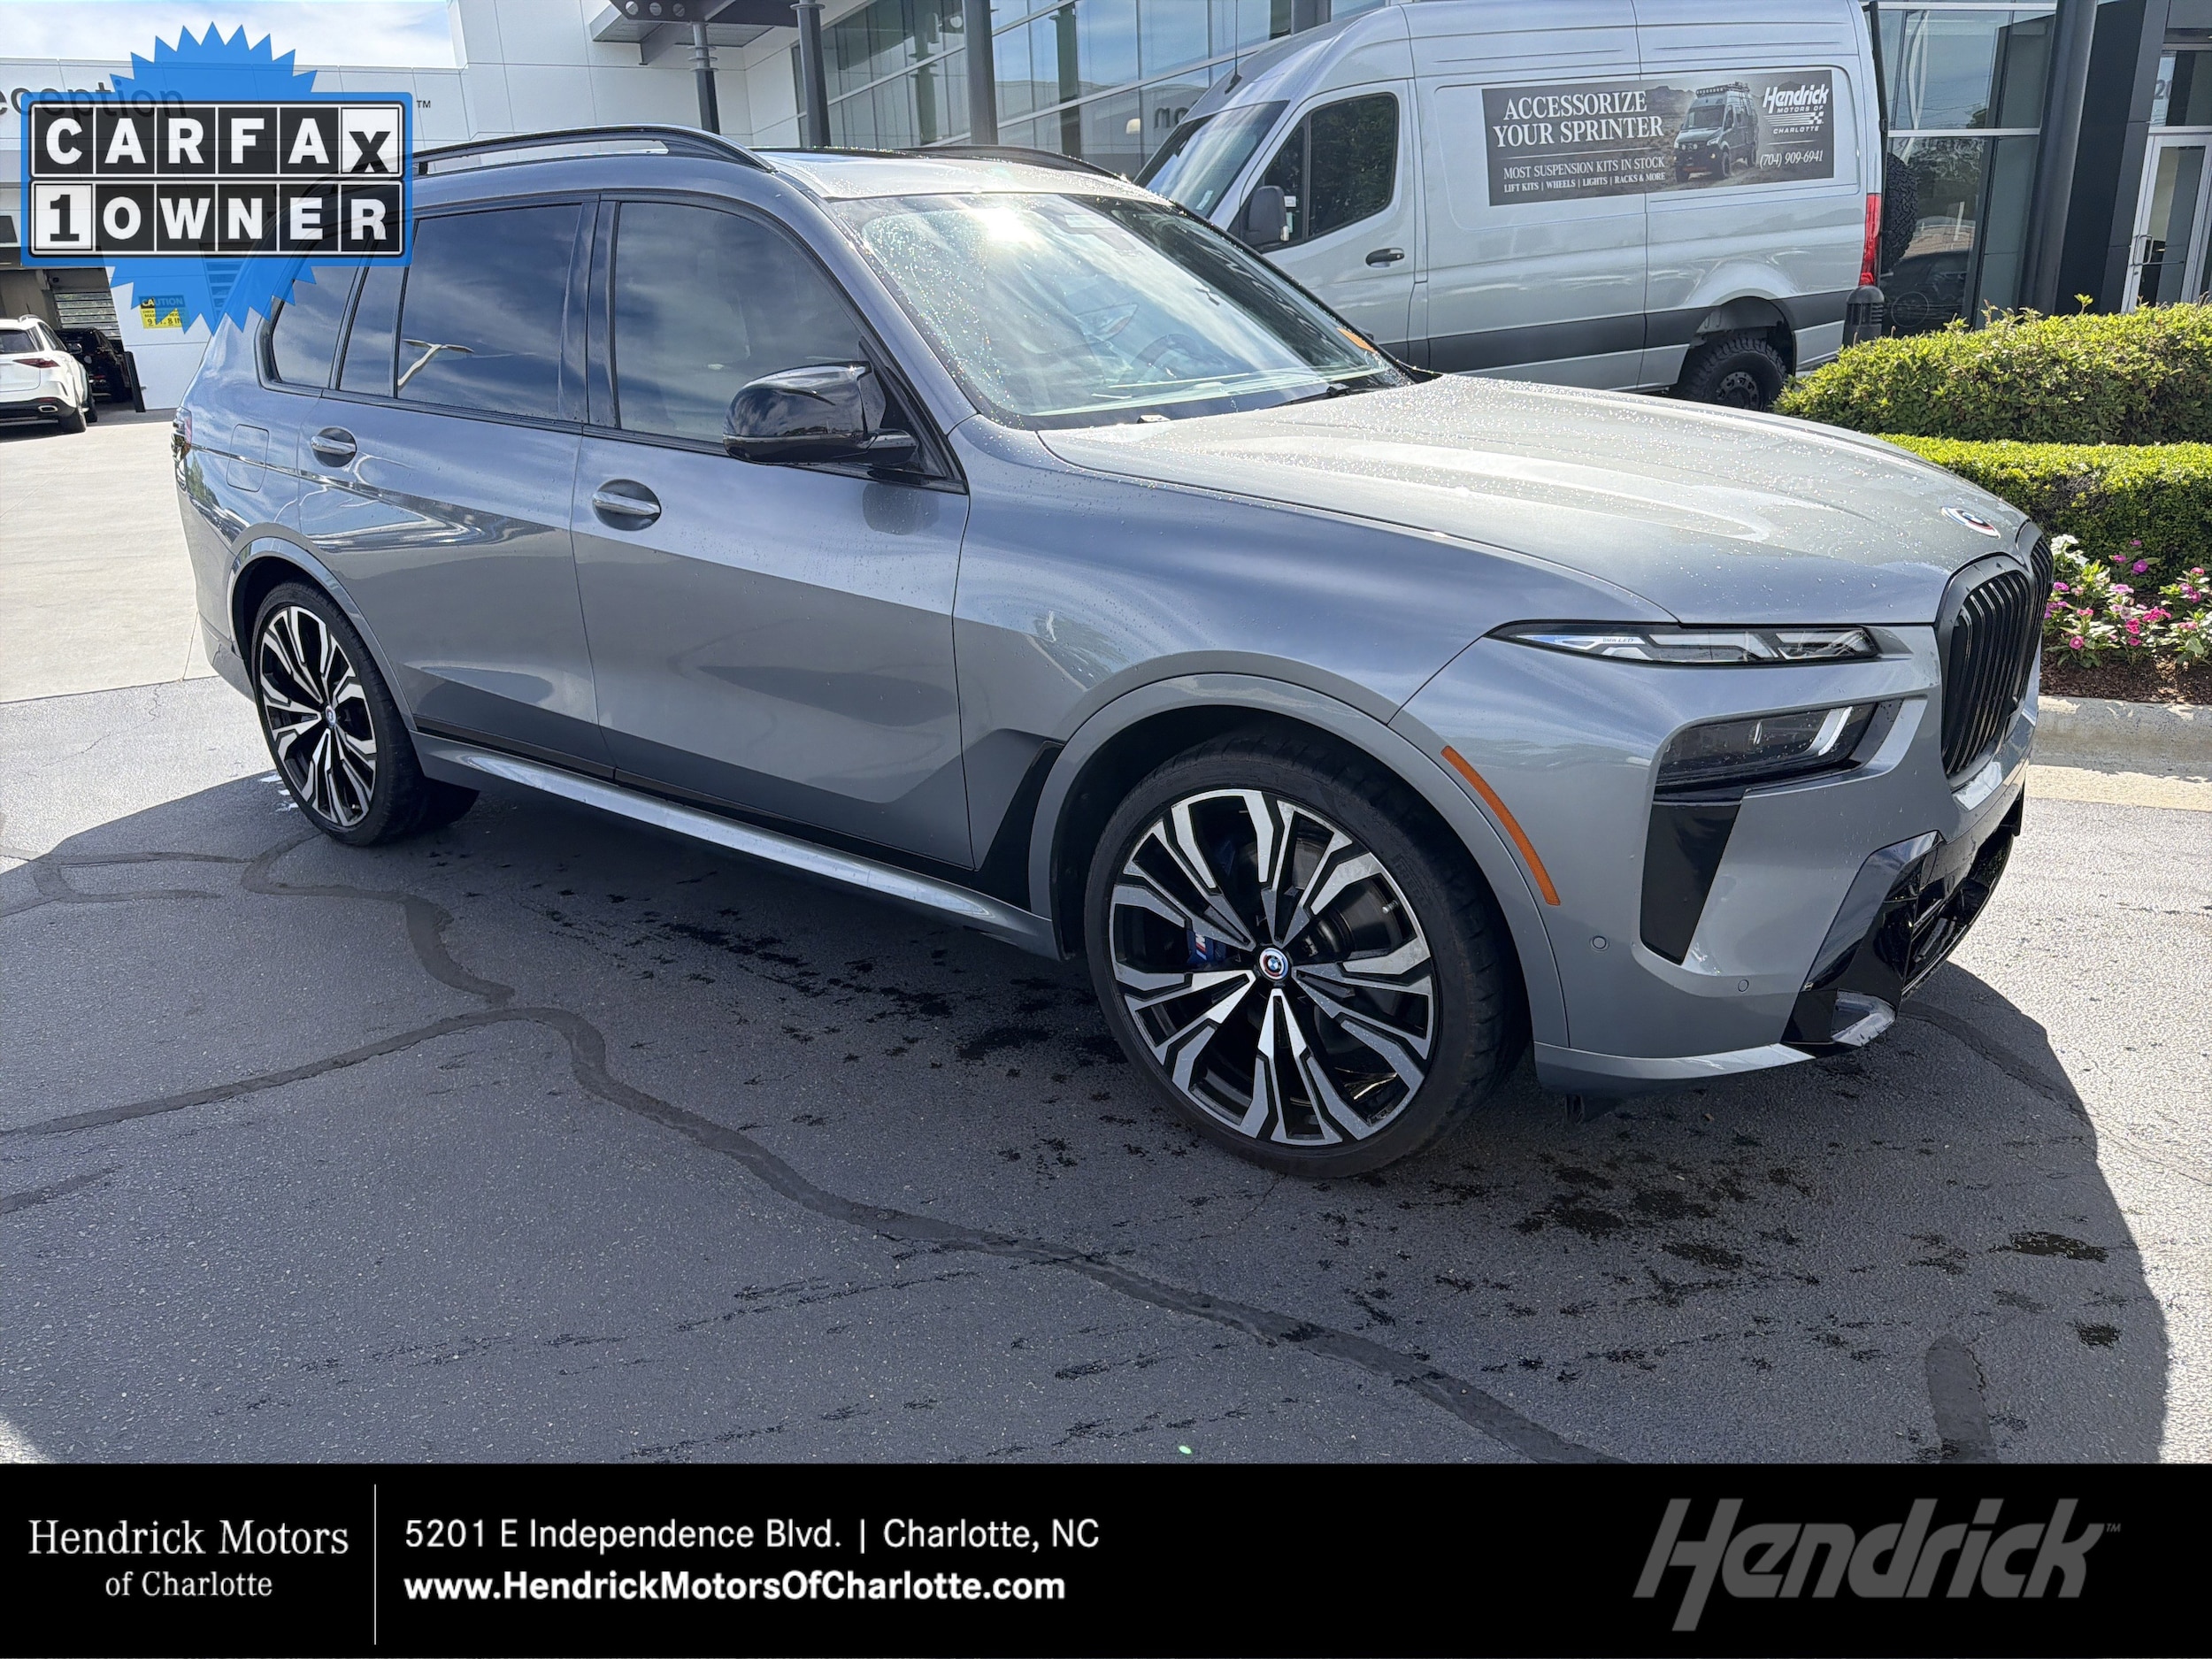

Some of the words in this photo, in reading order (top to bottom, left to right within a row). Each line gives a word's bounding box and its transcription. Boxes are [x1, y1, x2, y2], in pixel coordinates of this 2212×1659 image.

[1503, 91, 1647, 120] ACCESSORIZE
[1763, 84, 1829, 113] Hendrick
[1493, 123, 1555, 148] YOUR
[1560, 116, 1664, 143] SPRINTER
[1773, 126, 1819, 134] CHARLOTTE
[1503, 166, 1531, 180] MOST
[1533, 161, 1594, 178] SUSPENSION
[1596, 160, 1619, 173] KITS
[1621, 159, 1632, 170] IN
[1634, 157, 1665, 170] STOCK
[1760, 152, 1782, 169] (704)
[1785, 150, 1823, 165] 909-6941
[1504, 182, 1520, 193] LIFT
[1522, 181, 1539, 191] KITS
[1546, 179, 1576, 189] WHEELS
[1583, 177, 1608, 187] LIGHTS
[1615, 175, 1638, 184] RACKS
[1646, 173, 1666, 182] MORE
[142, 297, 183, 307] CAUTION
